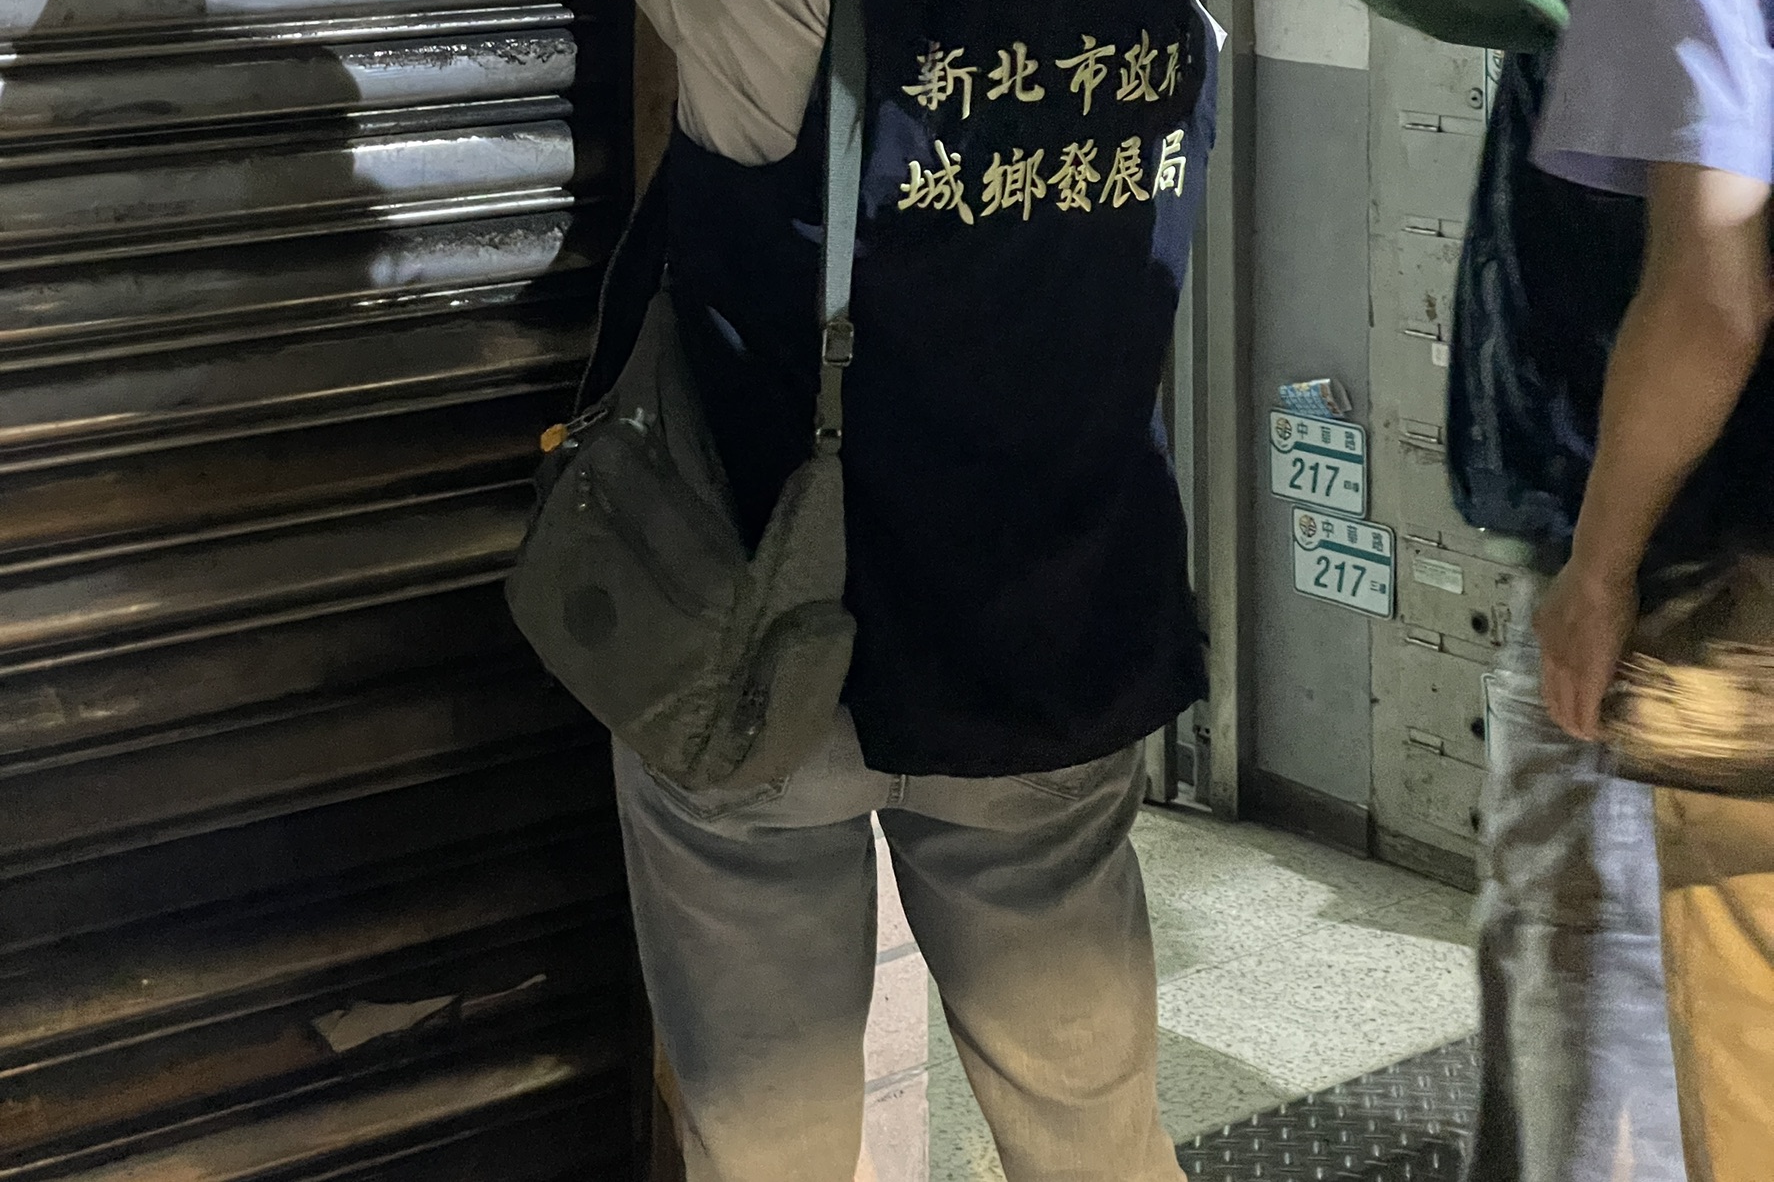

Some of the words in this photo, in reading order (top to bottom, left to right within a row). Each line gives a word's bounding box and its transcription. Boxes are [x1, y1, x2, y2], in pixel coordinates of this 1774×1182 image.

[897, 129, 1187, 225] 城鄉發展局
[1297, 422, 1356, 452] 中華路
[1289, 457, 1340, 497] 217
[1321, 519, 1384, 553] 中華路
[1314, 555, 1367, 597] 217
